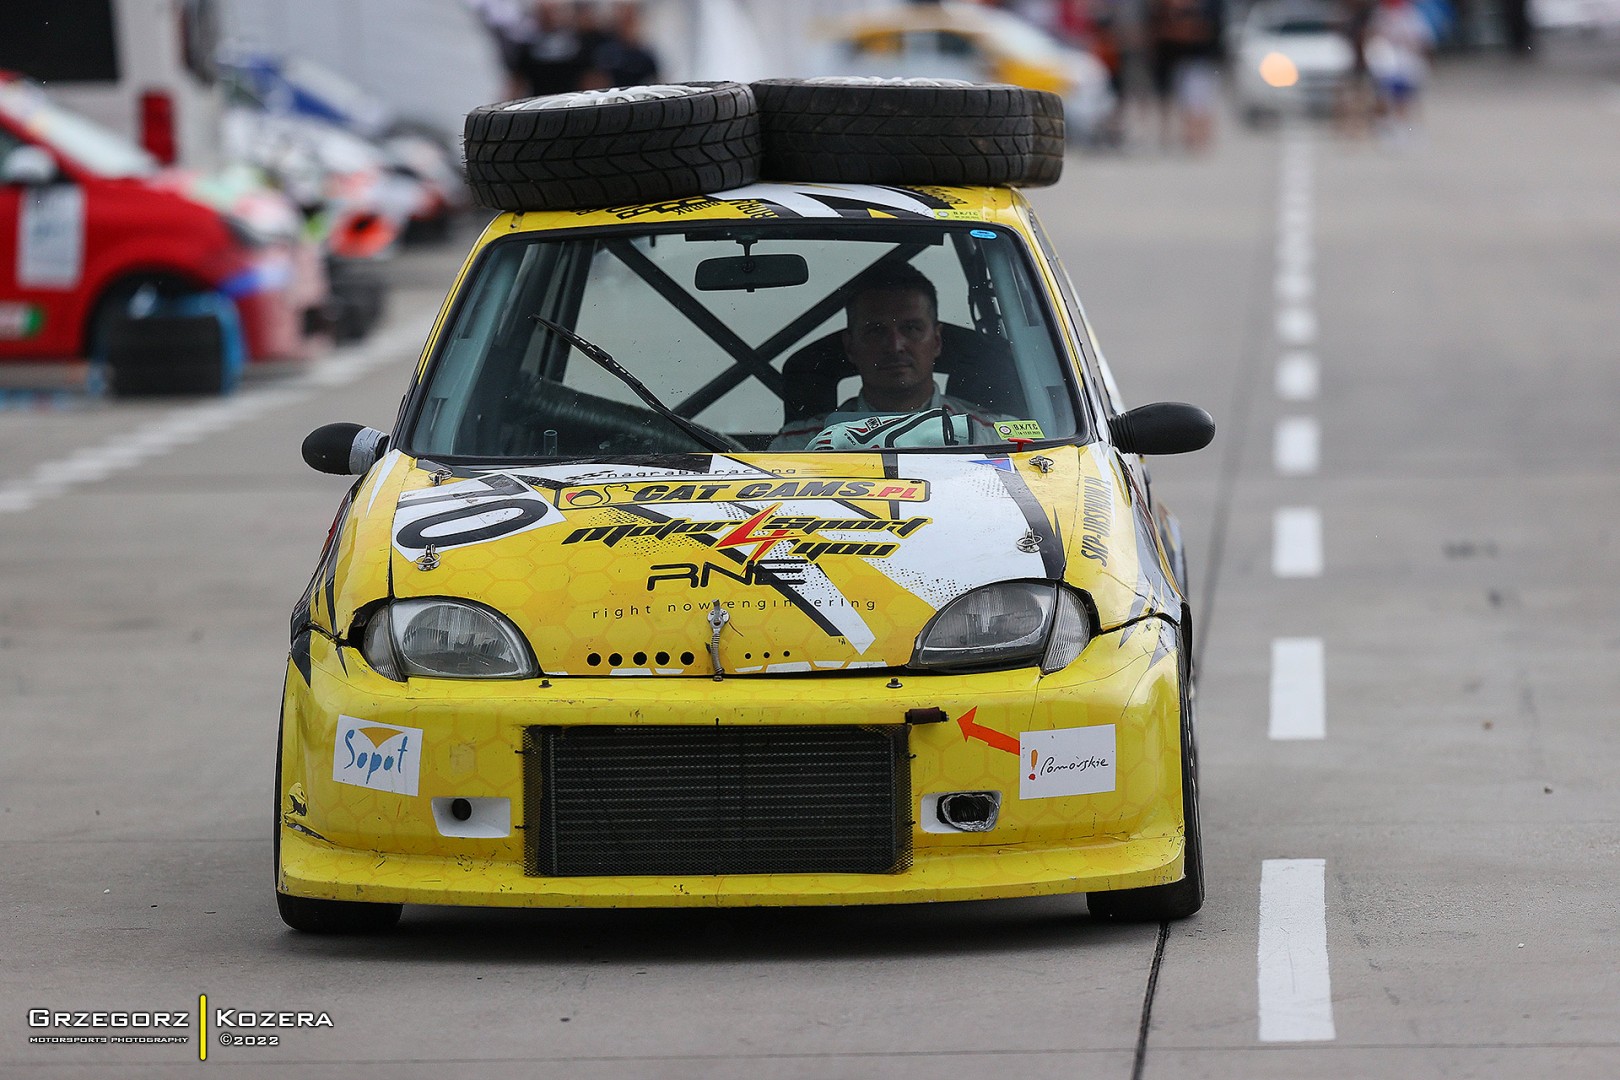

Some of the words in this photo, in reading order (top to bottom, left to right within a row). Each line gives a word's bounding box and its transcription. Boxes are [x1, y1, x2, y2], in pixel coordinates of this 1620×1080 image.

[632, 484, 730, 501] CAT
[592, 604, 652, 619] right
[667, 602, 711, 612] now
[727, 598, 876, 610] enginering
[344, 729, 408, 785] Sopot
